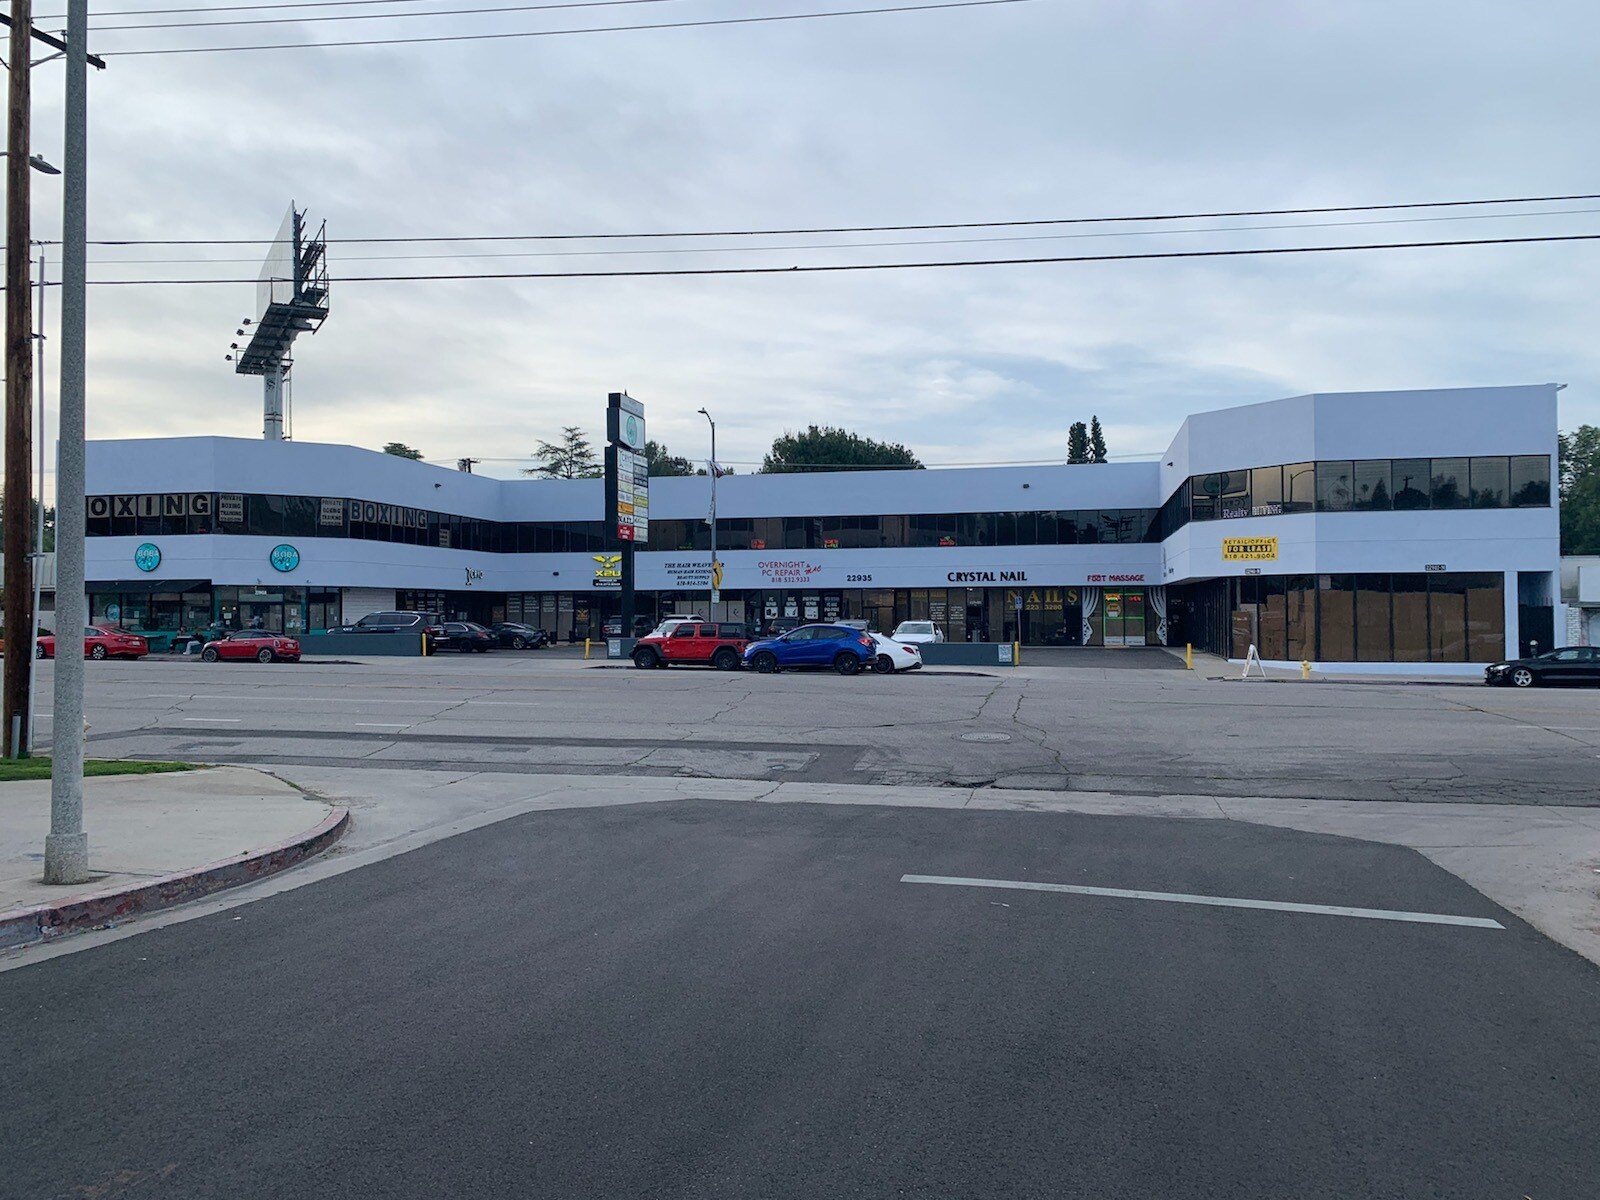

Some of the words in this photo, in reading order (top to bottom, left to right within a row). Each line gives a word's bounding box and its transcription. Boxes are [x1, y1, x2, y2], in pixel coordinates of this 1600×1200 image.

[351, 502, 427, 529] BOXING
[1223, 507, 1248, 518] Realty
[758, 561, 805, 569] OVERNIGHT
[774, 569, 801, 577] REPAIR
[947, 571, 996, 582] CRYSTAL
[1000, 571, 1027, 581] NAIL
[847, 574, 872, 582] 22935
[1109, 574, 1145, 582] MASSAGE
